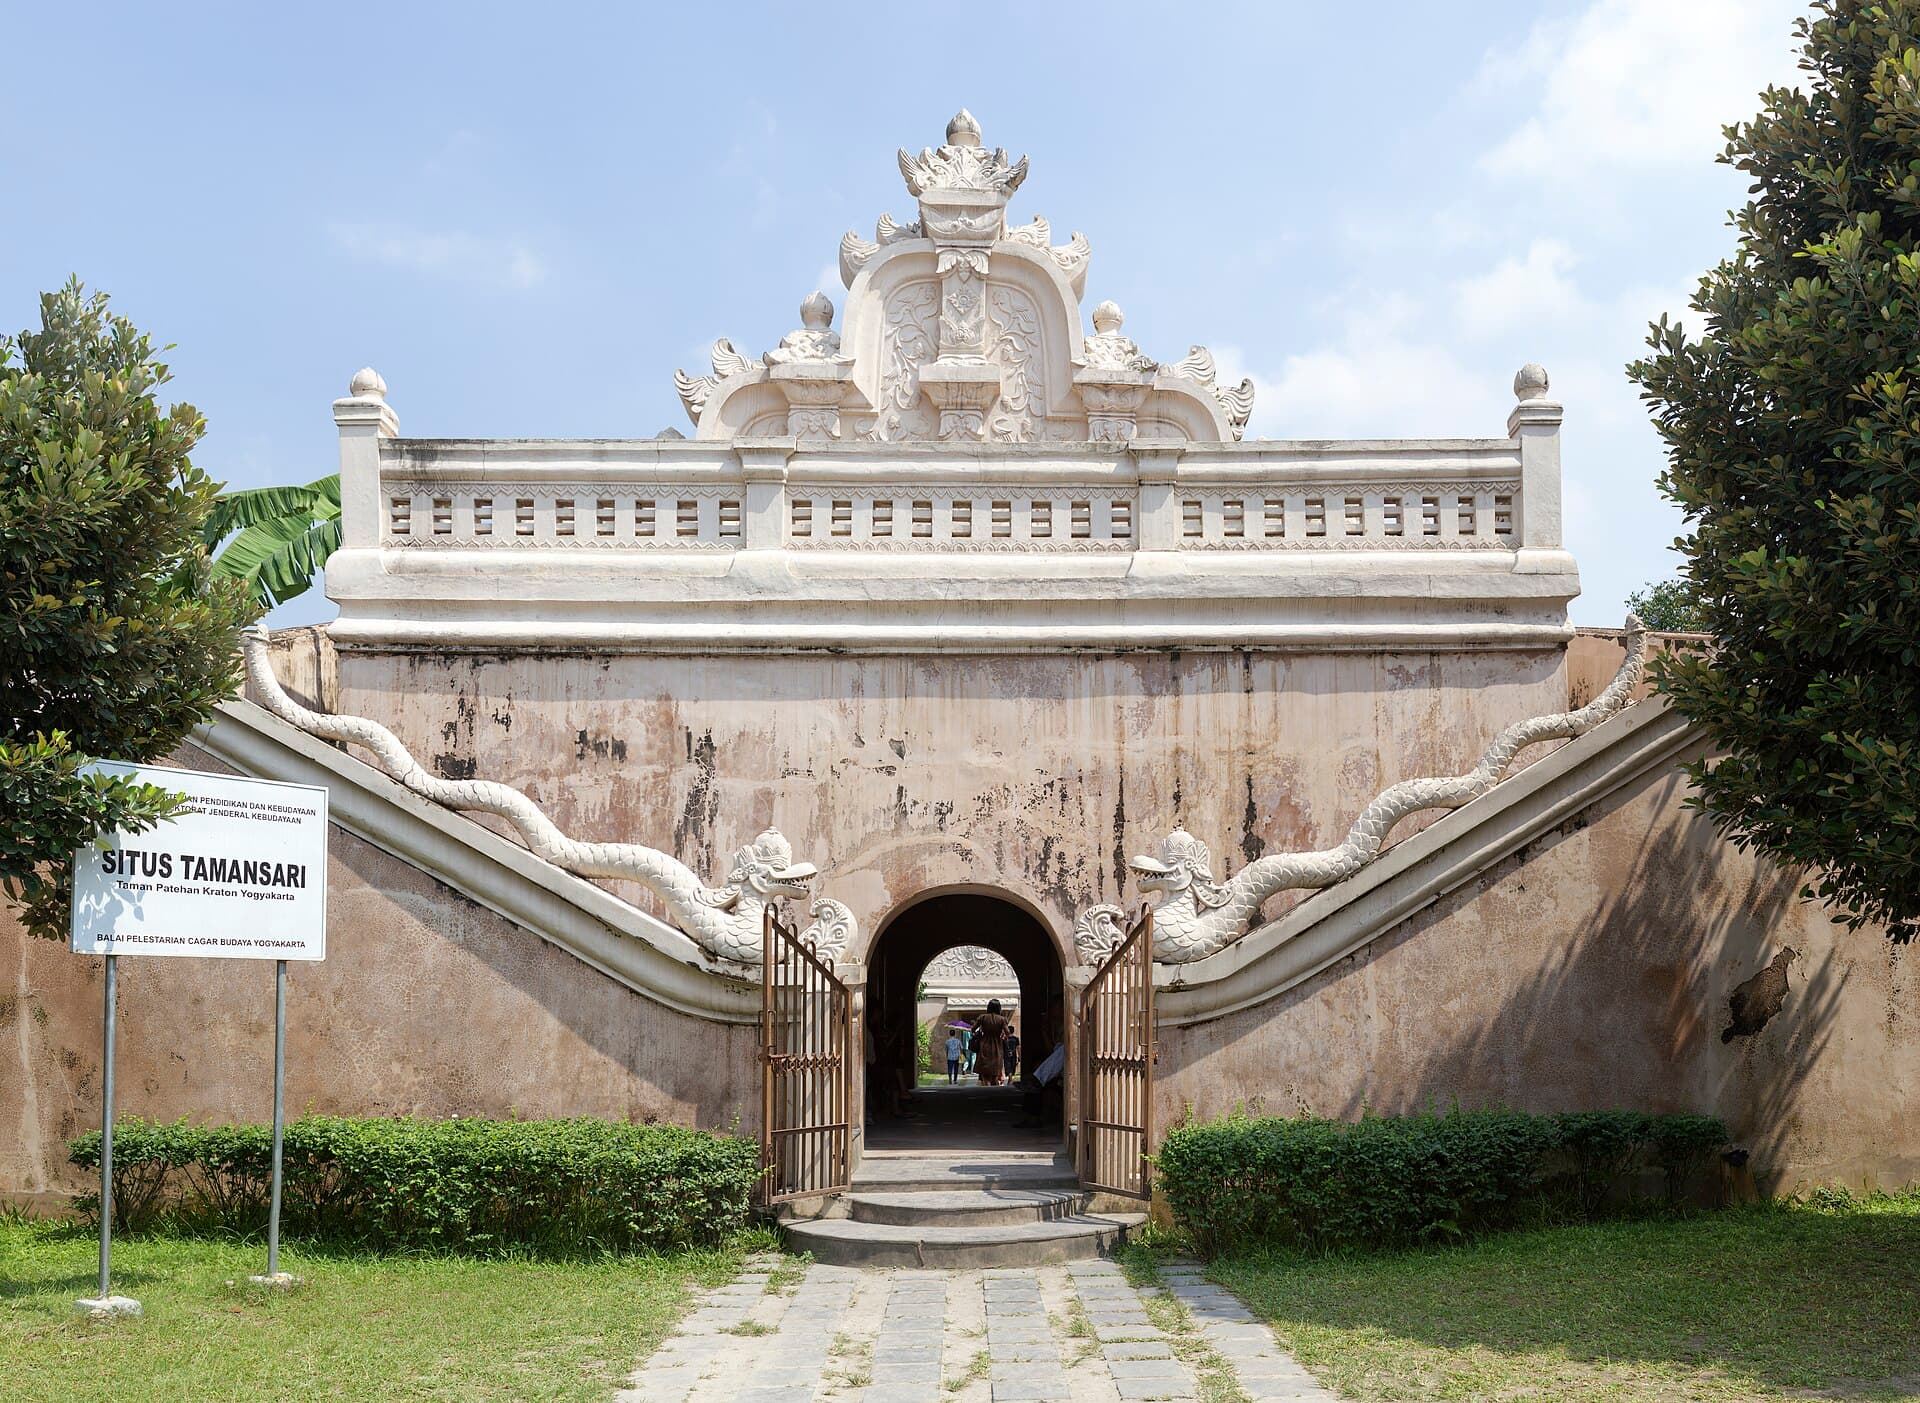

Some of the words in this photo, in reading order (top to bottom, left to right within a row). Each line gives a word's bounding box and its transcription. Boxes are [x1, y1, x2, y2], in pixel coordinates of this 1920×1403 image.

[200, 796, 248, 809] PENDIDIKAN
[249, 802, 266, 811] DAN
[267, 804, 316, 817] KEBUDAYAAN
[208, 808, 250, 820] JENDERAL
[251, 812, 302, 825] KEBUDAYAAN
[101, 848, 172, 879] SITUS
[180, 854, 306, 889] TAMANSARI
[116, 879, 153, 891] Taman
[156, 883, 200, 895] Patehan
[202, 886, 238, 897] Kraton
[240, 889, 295, 902] Yogyakarta
[97, 933, 124, 942] BALAI
[126, 934, 186, 945] PELESTARIAN
[187, 937, 218, 946] CAGAR
[220, 938, 253, 947] BUDAYA
[254, 939, 306, 949] YOGYAKARTA
